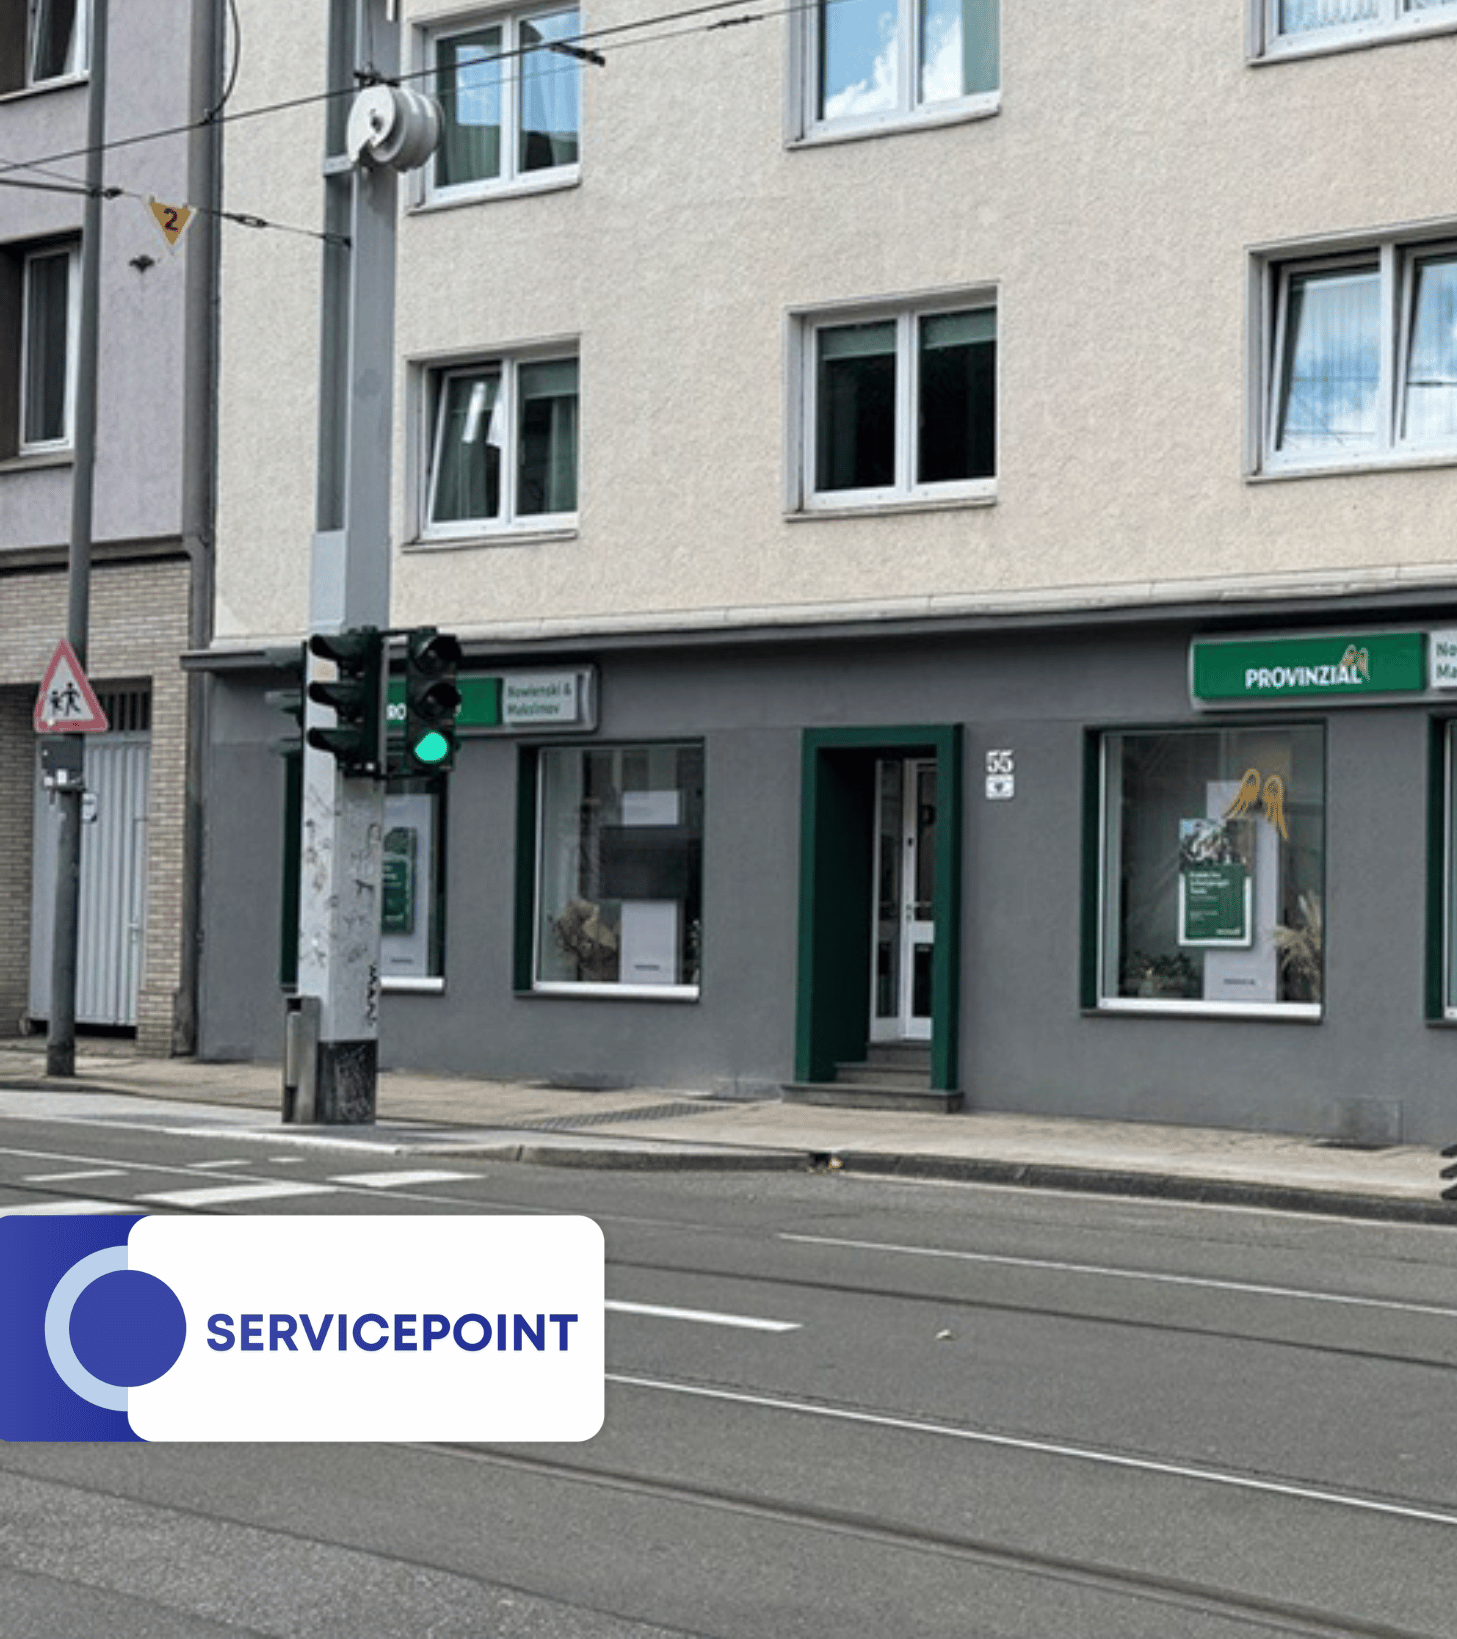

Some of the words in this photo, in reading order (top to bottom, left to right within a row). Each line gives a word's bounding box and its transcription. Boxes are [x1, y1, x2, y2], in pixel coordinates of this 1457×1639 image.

[163, 207, 179, 232] 2
[1245, 666, 1363, 689] PROVINZIAL
[986, 750, 1014, 773] 55
